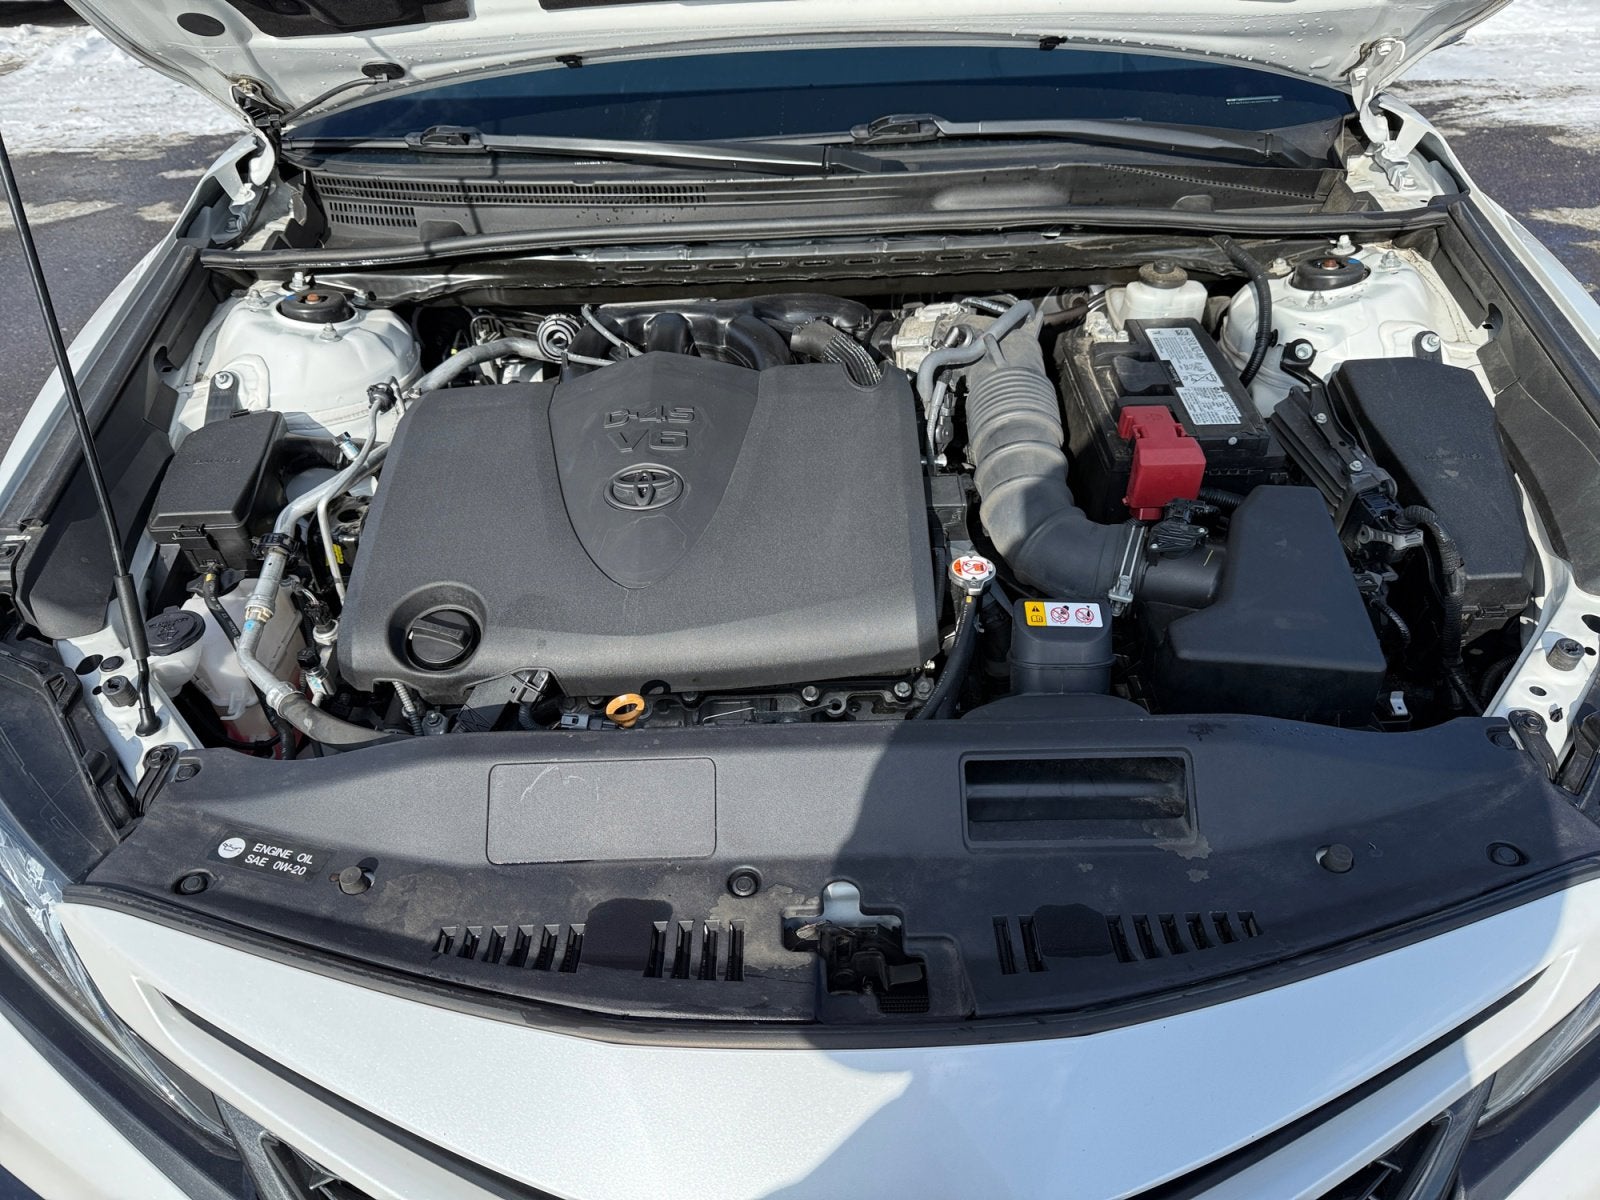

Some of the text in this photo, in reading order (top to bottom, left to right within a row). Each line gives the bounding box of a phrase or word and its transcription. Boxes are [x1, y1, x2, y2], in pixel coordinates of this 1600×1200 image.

[603, 405, 695, 429] D-4S
[607, 429, 689, 454] V6
[244, 854, 307, 876] SAE 0W-20
[252, 842, 314, 865] ENGINE OIL
